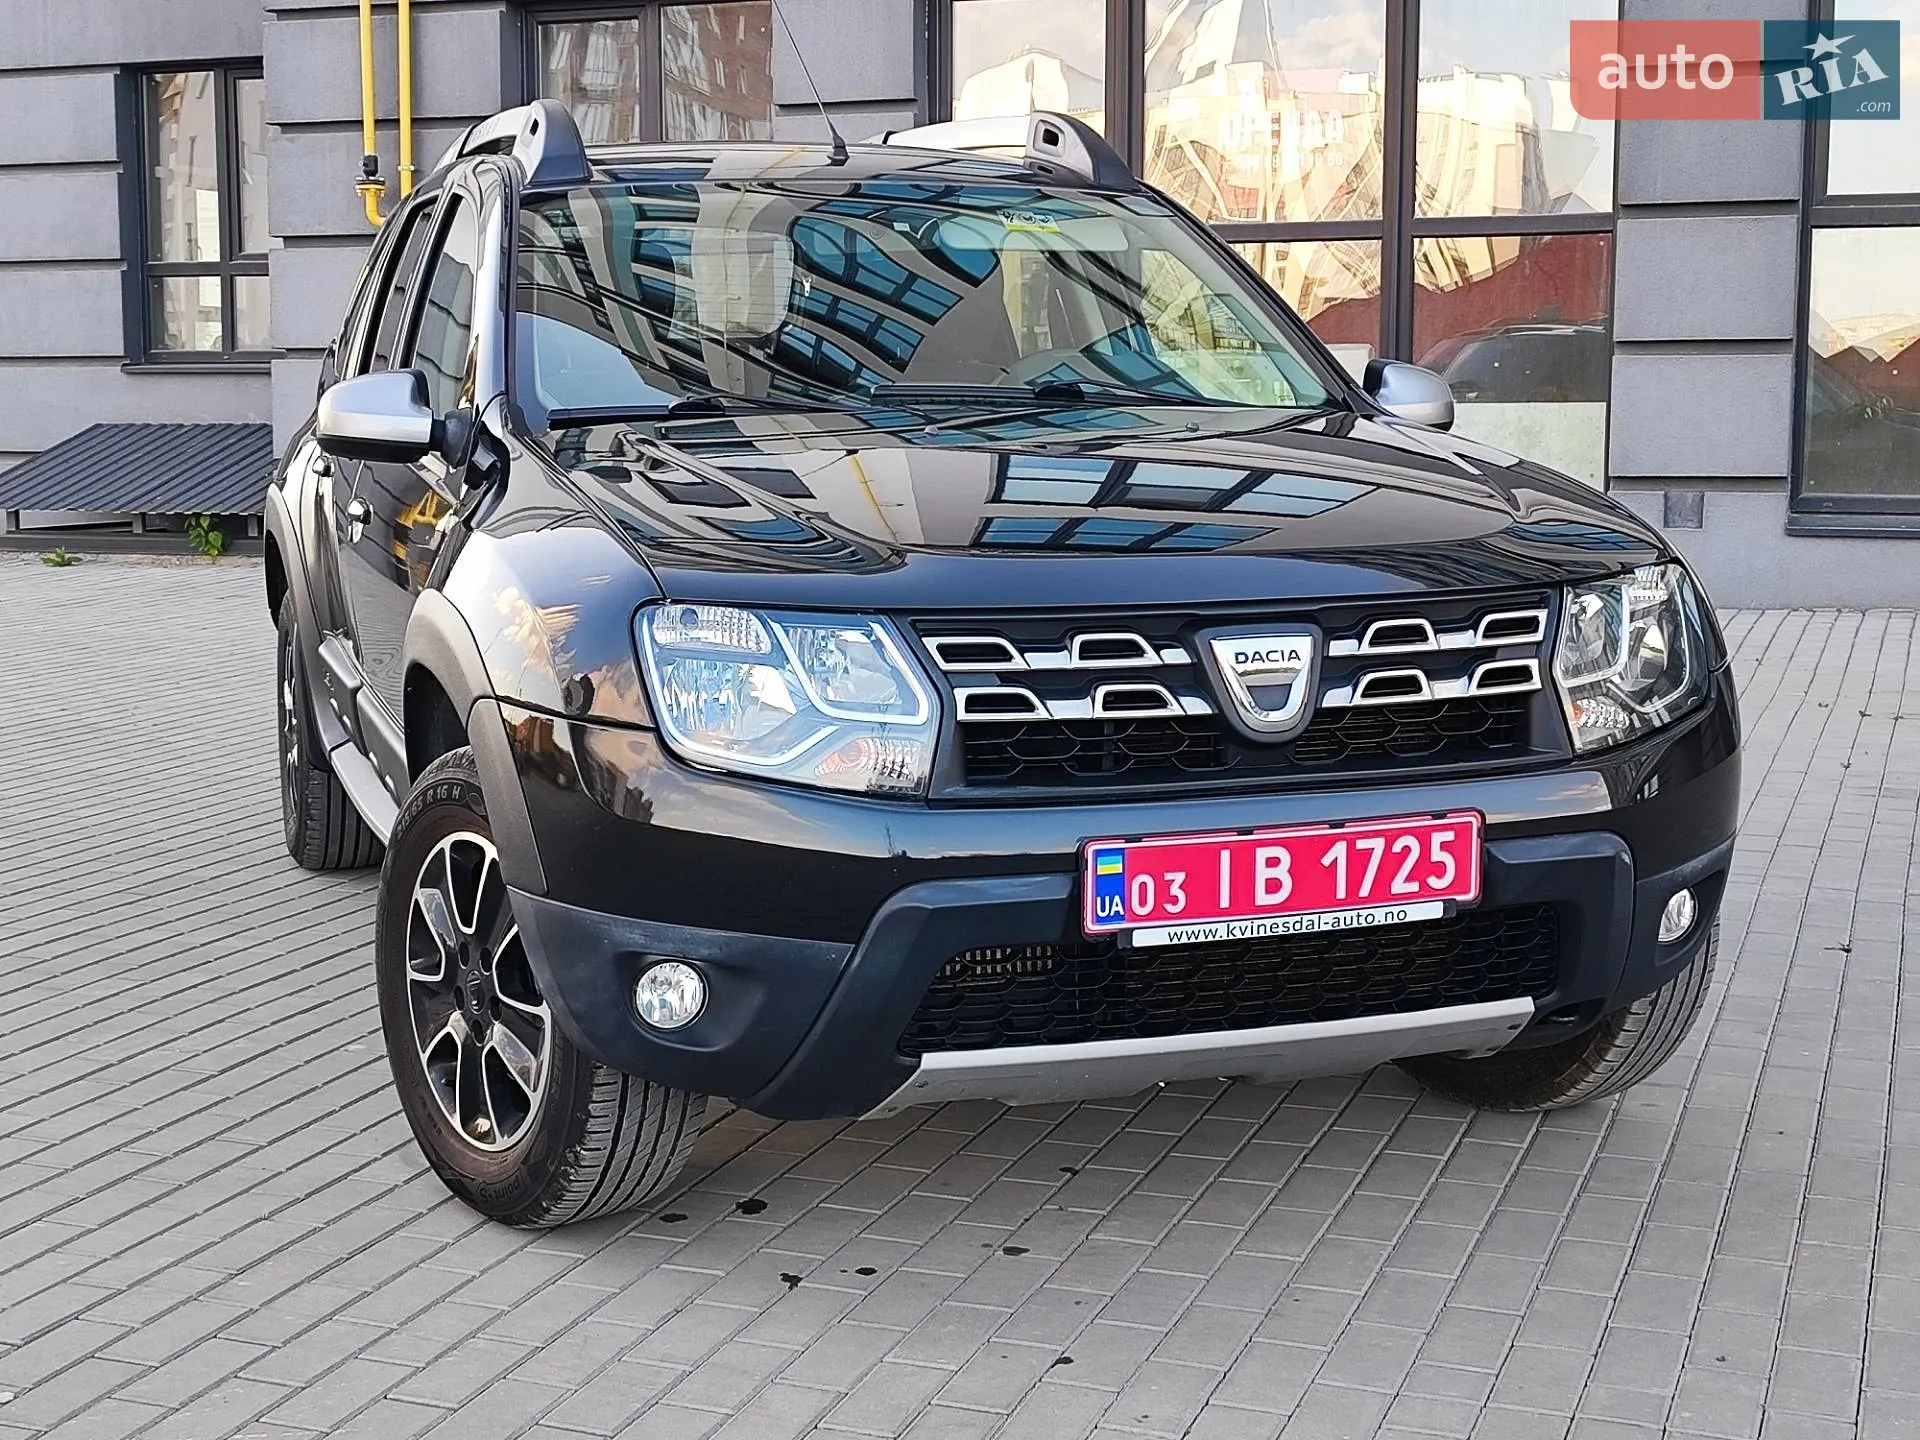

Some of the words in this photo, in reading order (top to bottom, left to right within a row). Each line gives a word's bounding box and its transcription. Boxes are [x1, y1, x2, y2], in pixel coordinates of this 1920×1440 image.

[1234, 649, 1301, 665] DACIA
[1130, 871, 1188, 916] 03
[1218, 845, 1294, 910] IB
[1319, 830, 1457, 900] 1725
[1096, 895, 1125, 919] UA
[1167, 907, 1408, 944] www.kvinesdal-auto.no
